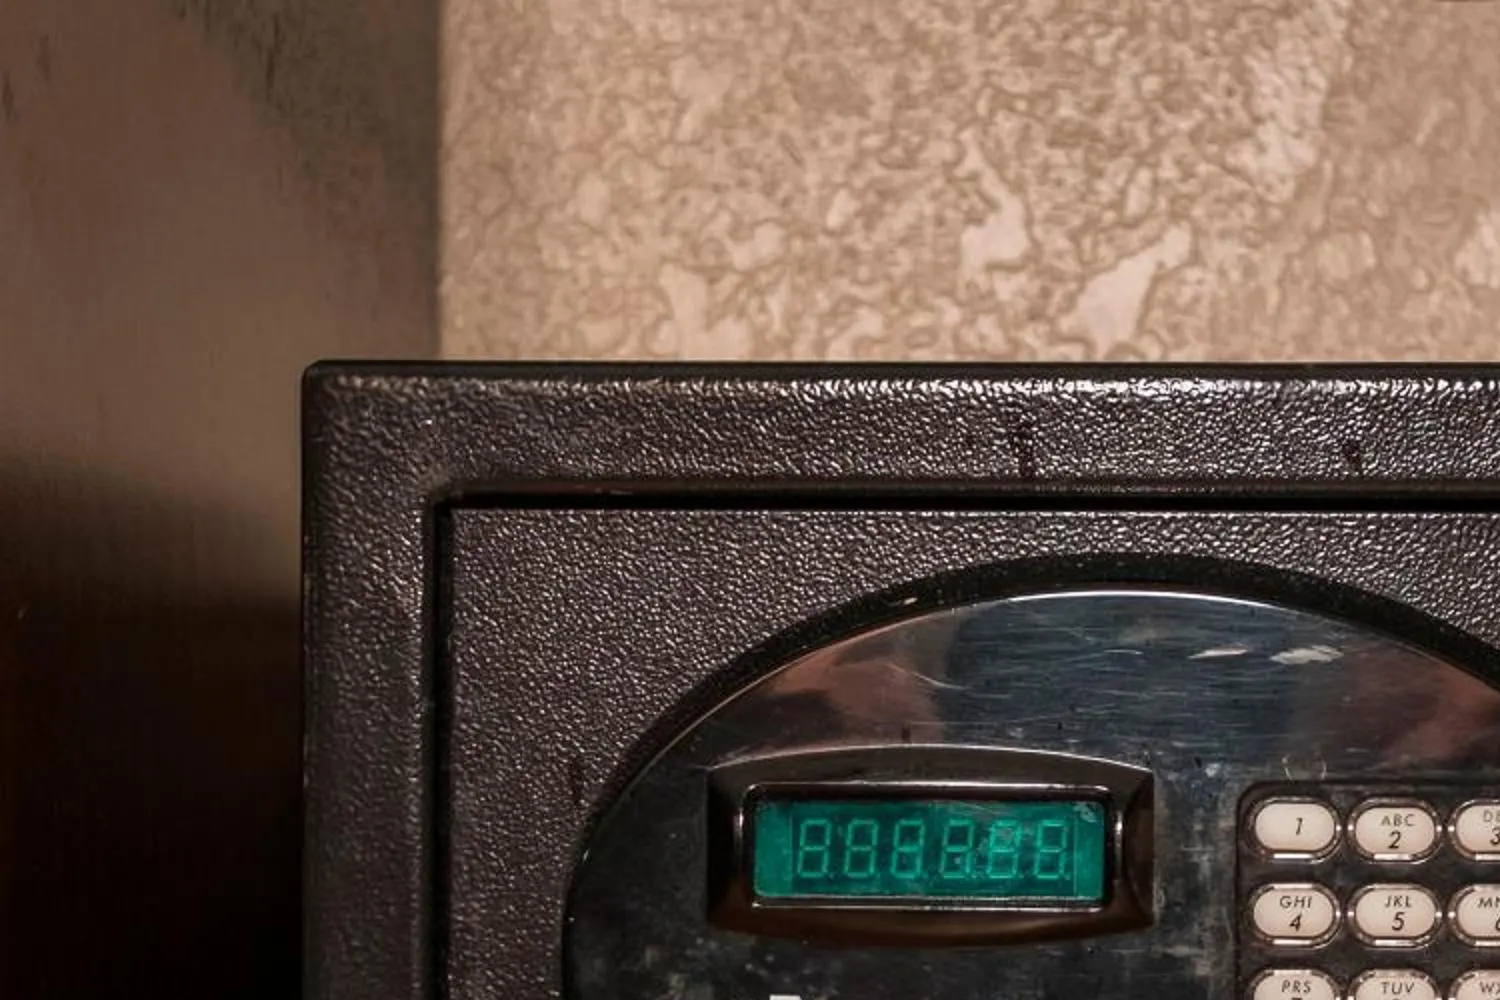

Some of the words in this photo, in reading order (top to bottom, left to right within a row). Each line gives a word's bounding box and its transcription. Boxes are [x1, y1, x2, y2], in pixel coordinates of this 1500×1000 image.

[1294, 817, 1304, 835] 1
[1380, 814, 1415, 827] ABC
[1388, 831, 1401, 849] 2
[1279, 896, 1313, 909] GHI
[1384, 896, 1412, 908] JKL
[1289, 913, 1302, 931] 4
[1392, 913, 1406, 931] 5
[1281, 981, 1312, 993] PRS
[1380, 982, 1415, 994] TUV
